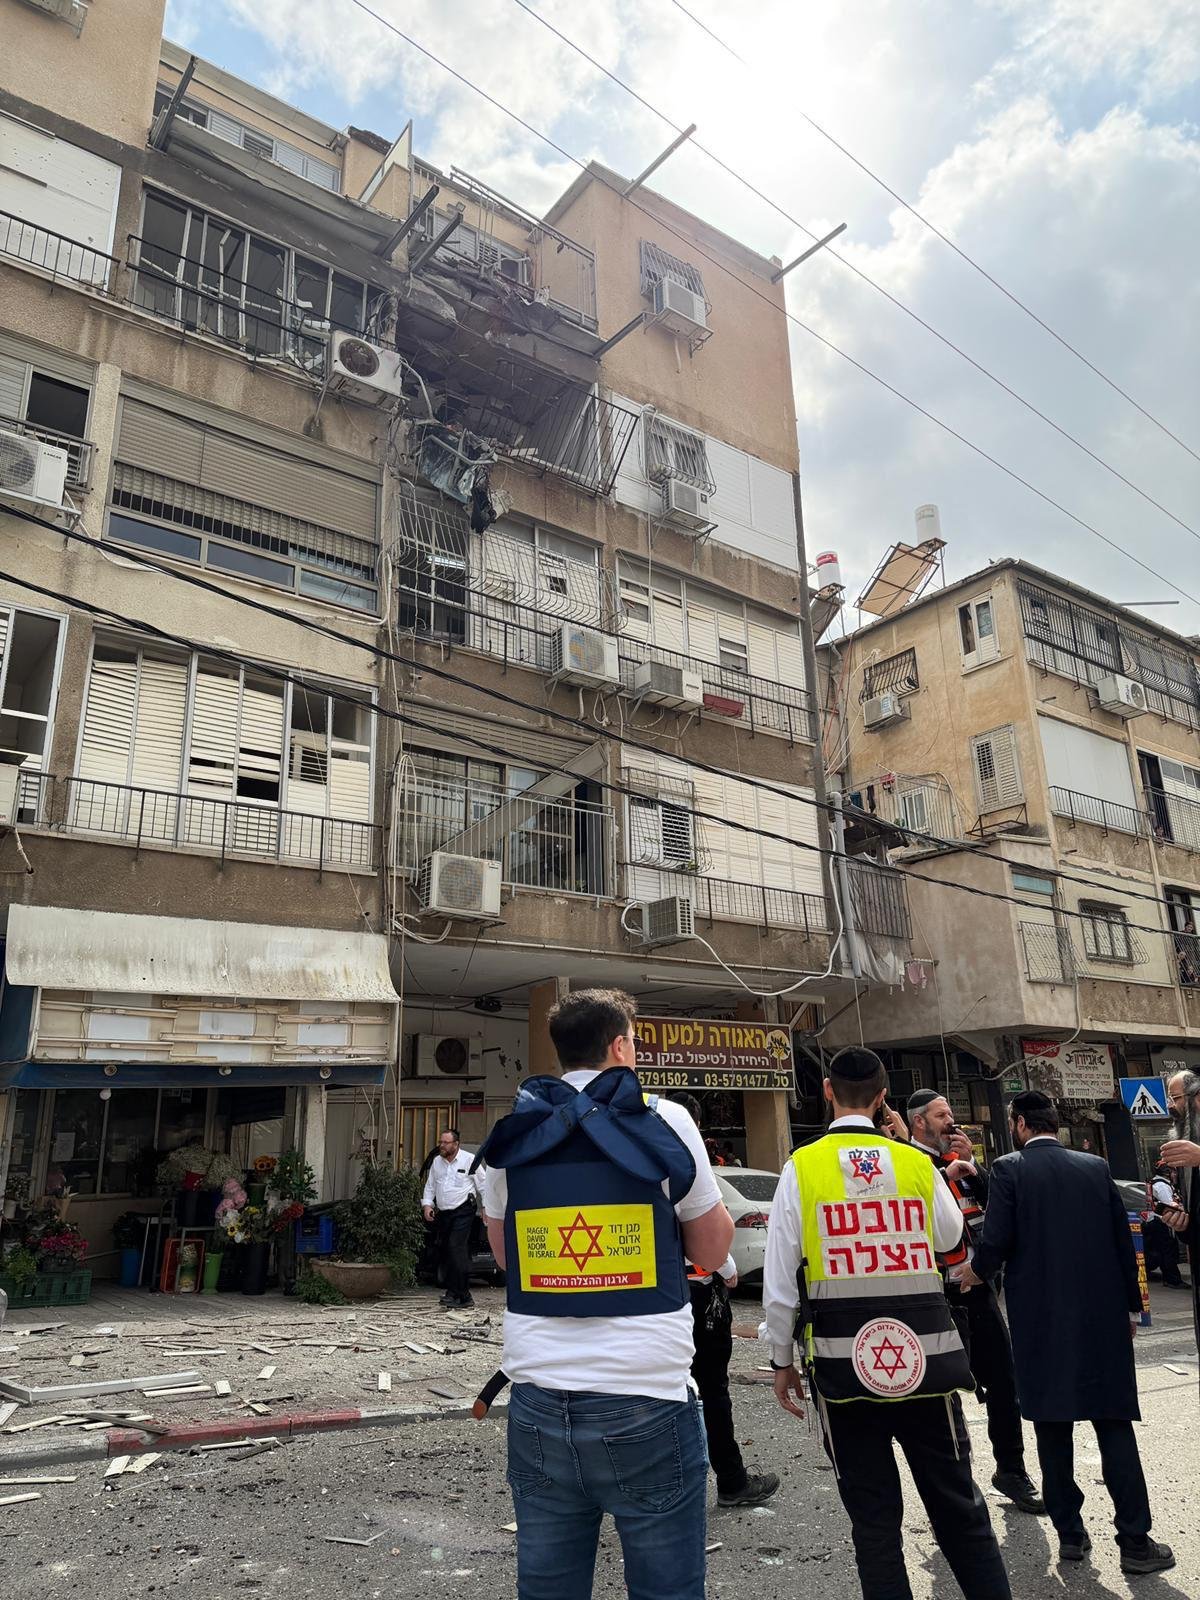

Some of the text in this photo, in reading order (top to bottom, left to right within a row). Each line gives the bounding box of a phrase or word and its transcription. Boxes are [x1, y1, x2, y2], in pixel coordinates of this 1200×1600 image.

[632, 1021, 767, 1052] האגודה למען הז
[657, 1053, 684, 1066] בזקן
[687, 1051, 727, 1064] לטיפול
[730, 1054, 769, 1066] היחידה
[705, 1073, 768, 1087] 03-5791477
[848, 1148, 880, 1159] הצלה
[823, 1200, 925, 1237] חובש
[527, 1227, 548, 1235] MAGEN
[608, 1223, 640, 1234] מגן דוד
[527, 1235, 546, 1243] DAVID
[618, 1234, 641, 1245] אדום
[606, 1245, 641, 1257] בישראל
[828, 1241, 932, 1275] הצלה
[540, 1275, 629, 1287] ארגון ההצלה הלאומי
[897, 1328, 909, 1338] דוד
[858, 1328, 876, 1351] בישראל
[906, 1338, 917, 1351] מגן
[860, 1358, 920, 1391] MAGEN DAVID ADOM IN ISRAEL
